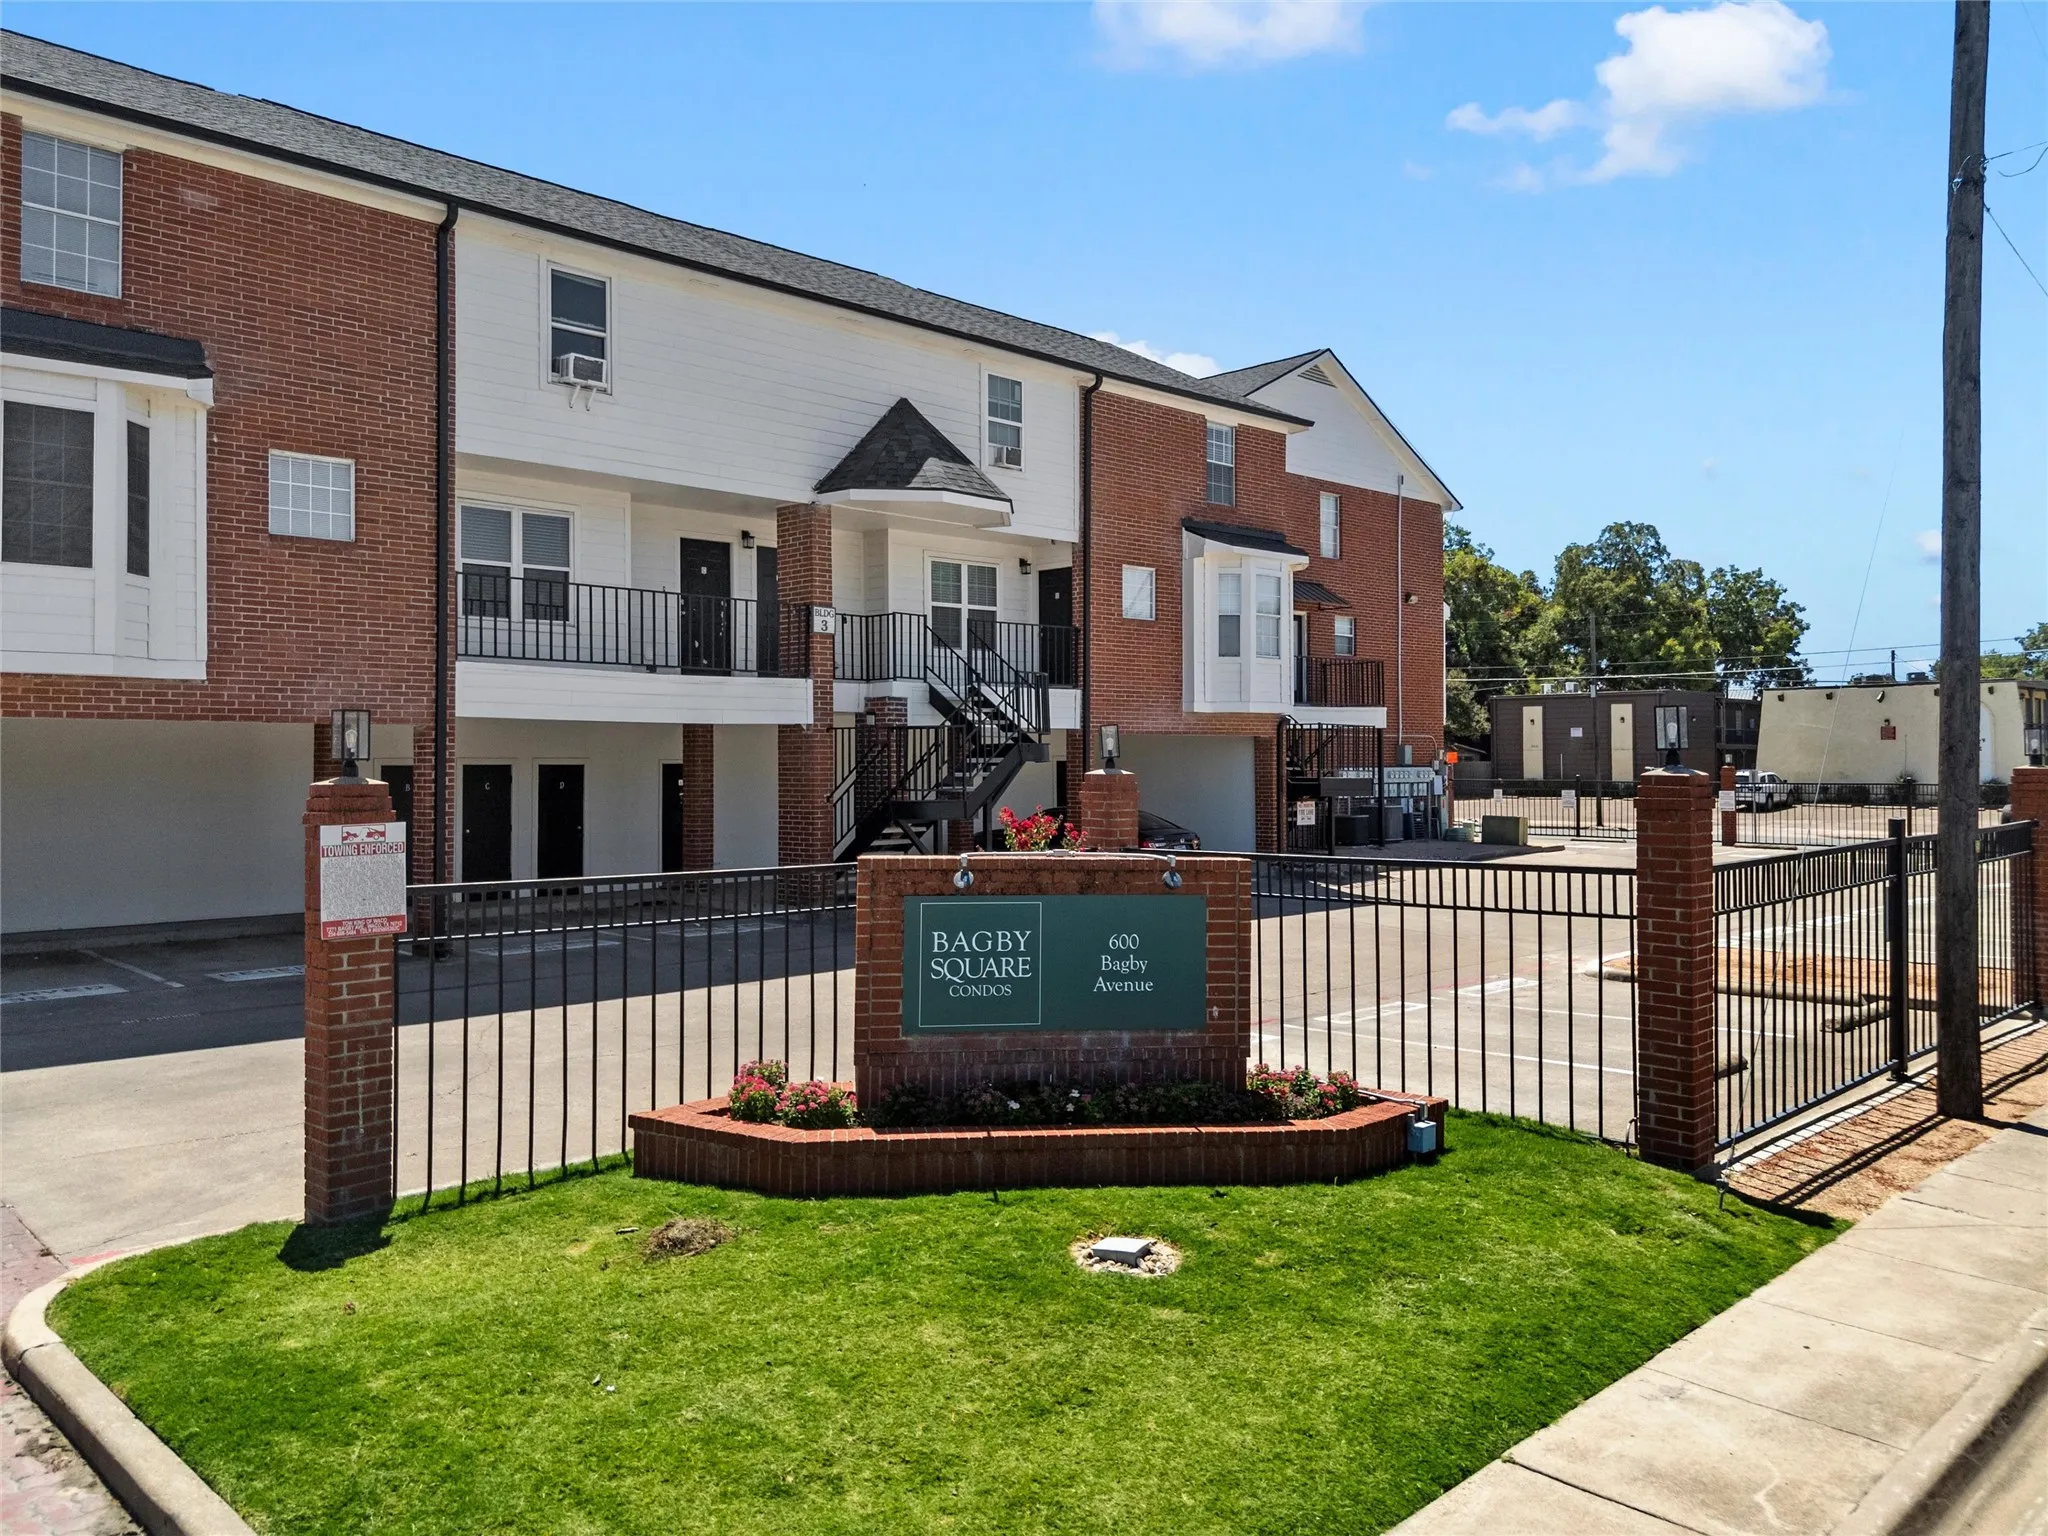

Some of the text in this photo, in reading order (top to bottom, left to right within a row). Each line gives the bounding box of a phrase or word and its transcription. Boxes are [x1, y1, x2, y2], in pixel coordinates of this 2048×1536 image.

[815, 609, 835, 618] BLDG
[821, 619, 828, 632] 3
[559, 781, 565, 790] D
[323, 842, 404, 857] TOWING ENFORCED
[931, 930, 1032, 952] BAGBY
[1108, 933, 1140, 950] 600
[930, 957, 1032, 983] SQUARE
[1100, 954, 1148, 974] Bagby
[949, 983, 1012, 997] CONDOS
[1093, 976, 1154, 992] Avenue
